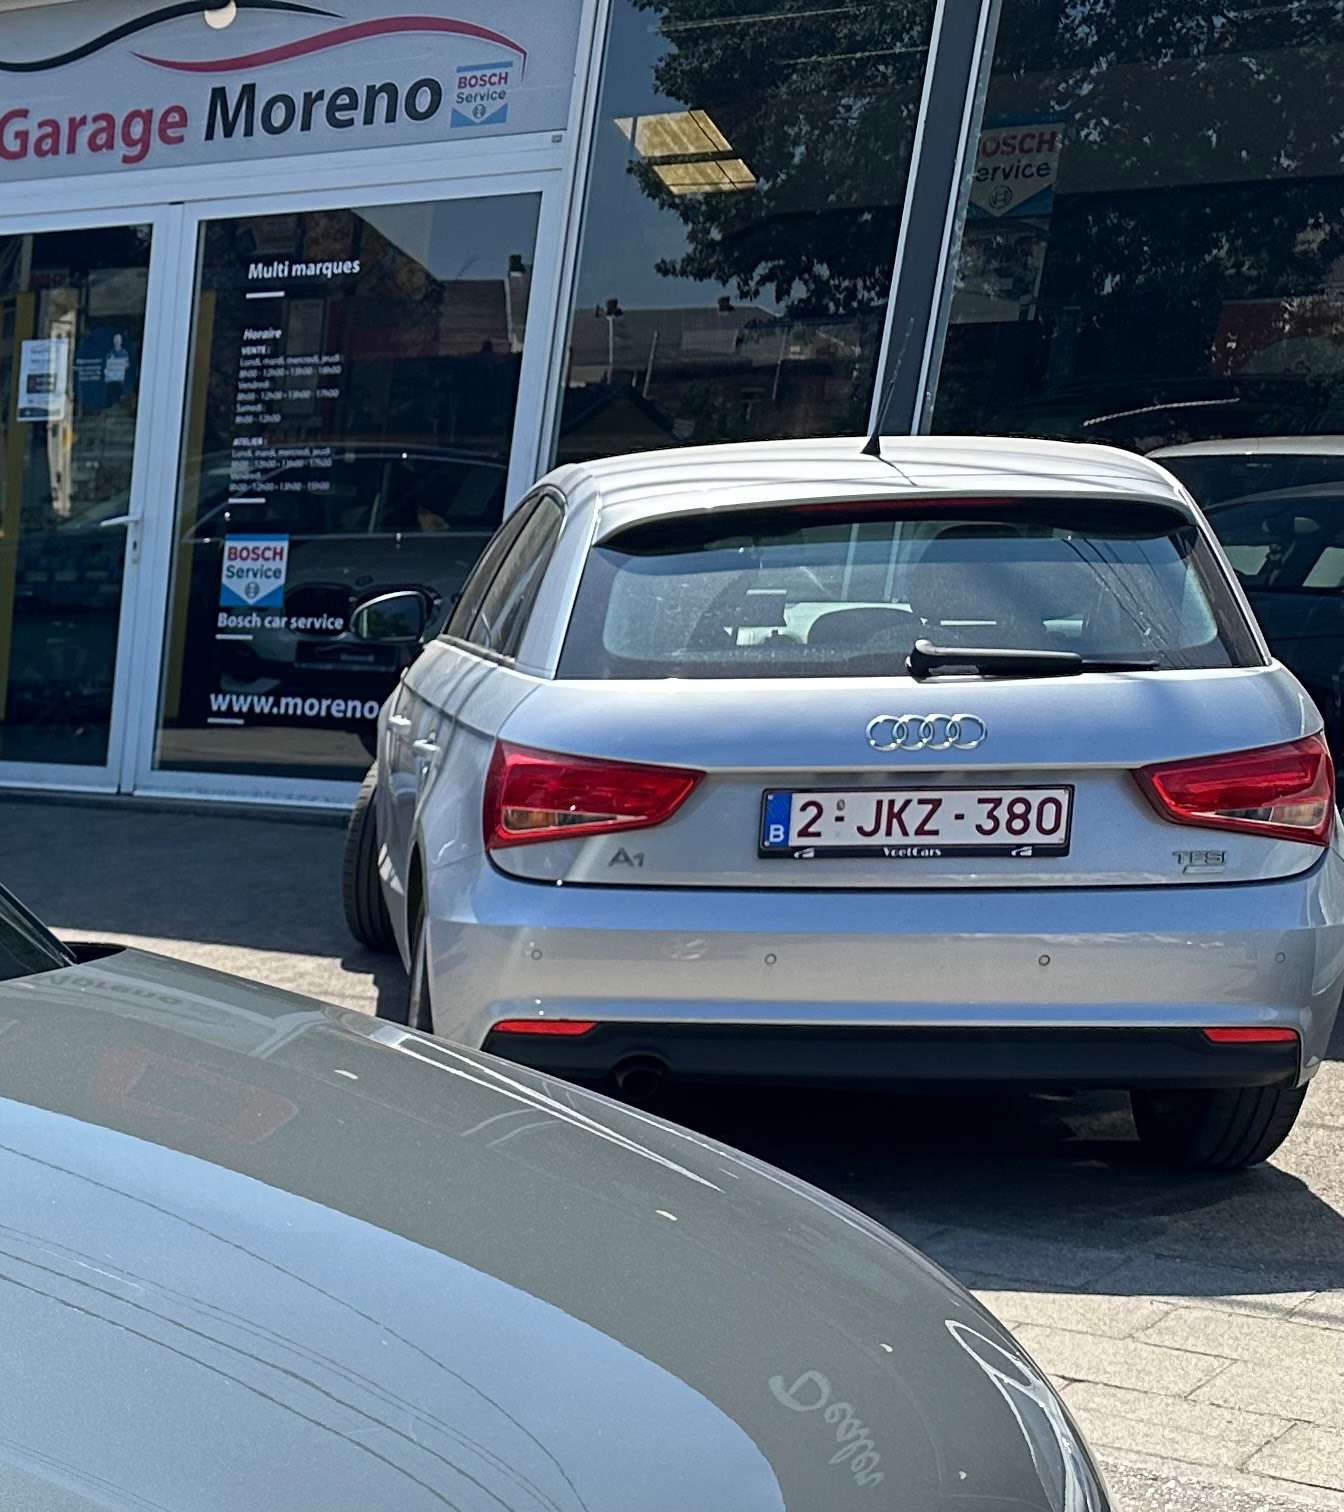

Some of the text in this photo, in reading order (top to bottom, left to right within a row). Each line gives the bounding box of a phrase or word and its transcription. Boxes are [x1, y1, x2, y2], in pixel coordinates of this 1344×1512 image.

[457, 71, 509, 89] BOSCH
[455, 89, 507, 104] Service
[203, 75, 443, 142] Moreno
[248, 260, 361, 280] Multi marques
[243, 327, 282, 341] Horaire
[227, 546, 284, 561] BOSCH
[226, 565, 282, 580] Service
[217, 612, 344, 630] Bosch car service
[796, 797, 1063, 838] 2-JKZ-380
[768, 824, 785, 843] B
[608, 847, 645, 867] A1
